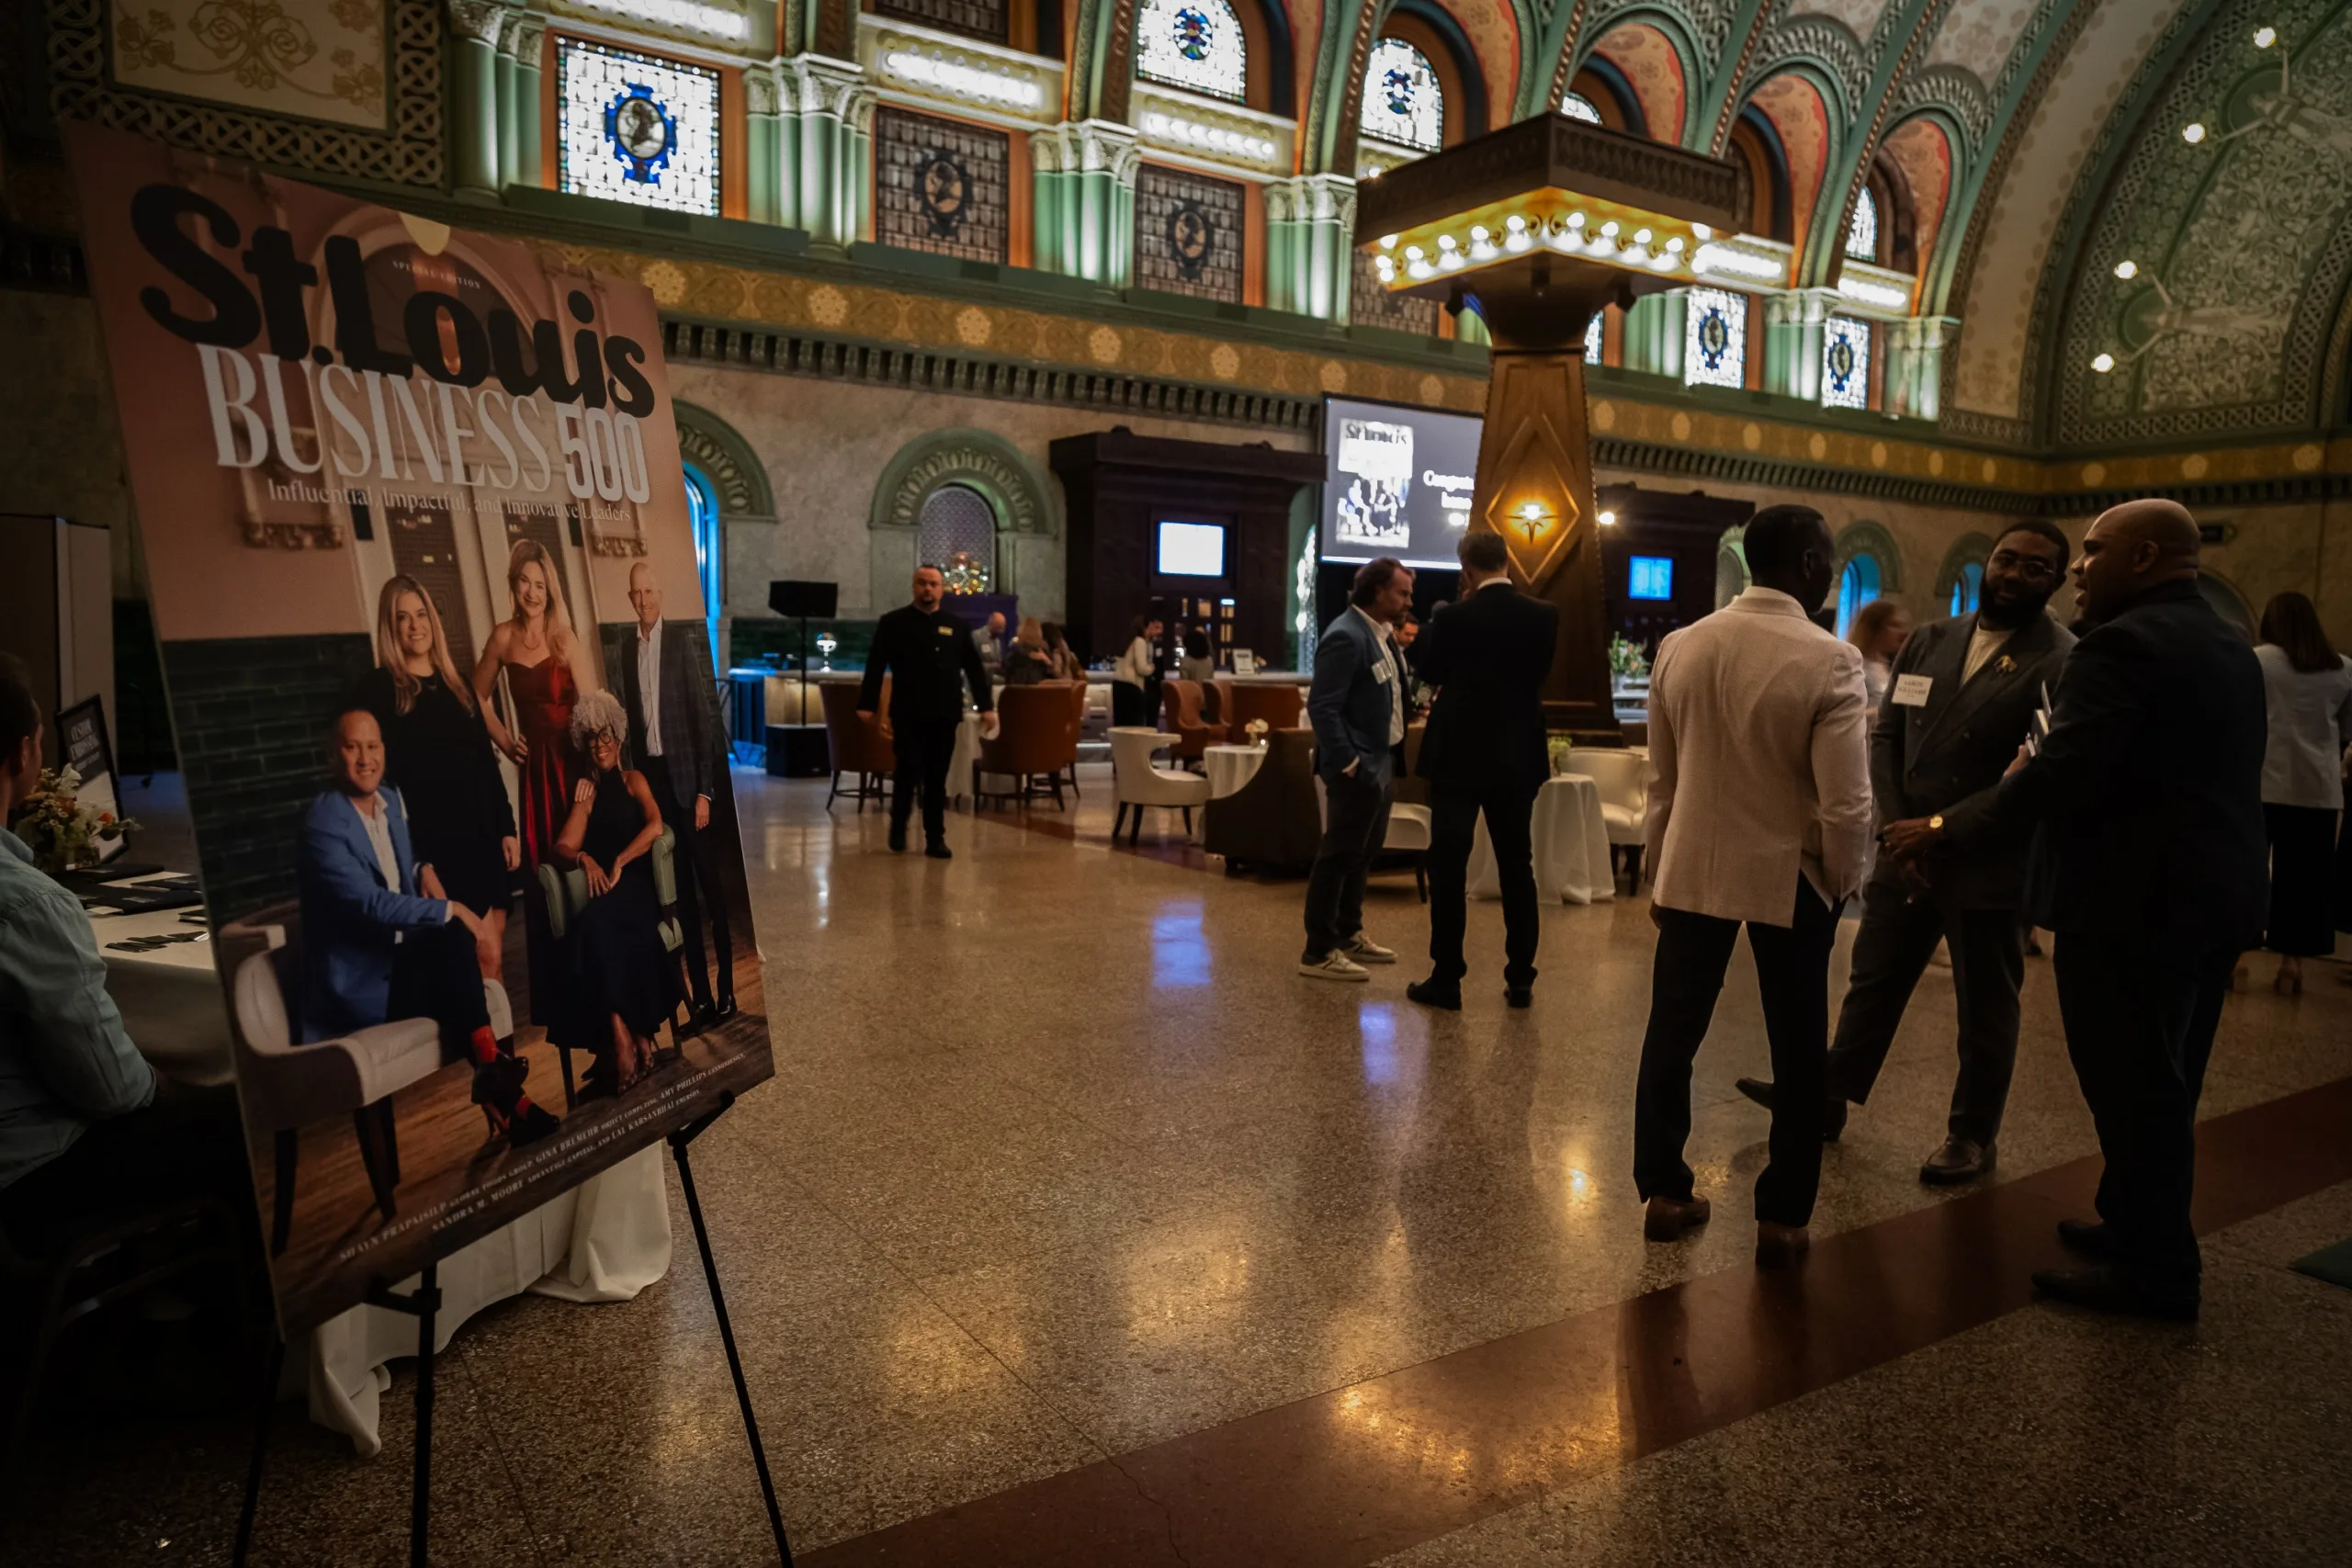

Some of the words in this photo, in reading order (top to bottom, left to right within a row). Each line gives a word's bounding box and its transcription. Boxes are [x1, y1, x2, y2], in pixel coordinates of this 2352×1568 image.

[197, 344, 551, 493] BUSINESS
[556, 404, 650, 504] 500
[268, 478, 379, 510] Influential,
[383, 487, 470, 513] Impactful,
[475, 497, 503, 514] and
[506, 501, 579, 520] Innovative
[582, 503, 631, 522] Leaders
[431, 1206, 474, 1233] SANDRA
[490, 1179, 525, 1203] MOORE
[611, 1126, 627, 1140] LAL
[449, 1187, 481, 1208] GLOBAL
[536, 1146, 558, 1164] GINA
[601, 1114, 624, 1130] OBJECT
[661, 1085, 676, 1100] AMY
[677, 1072, 707, 1092] PHILLIPS
